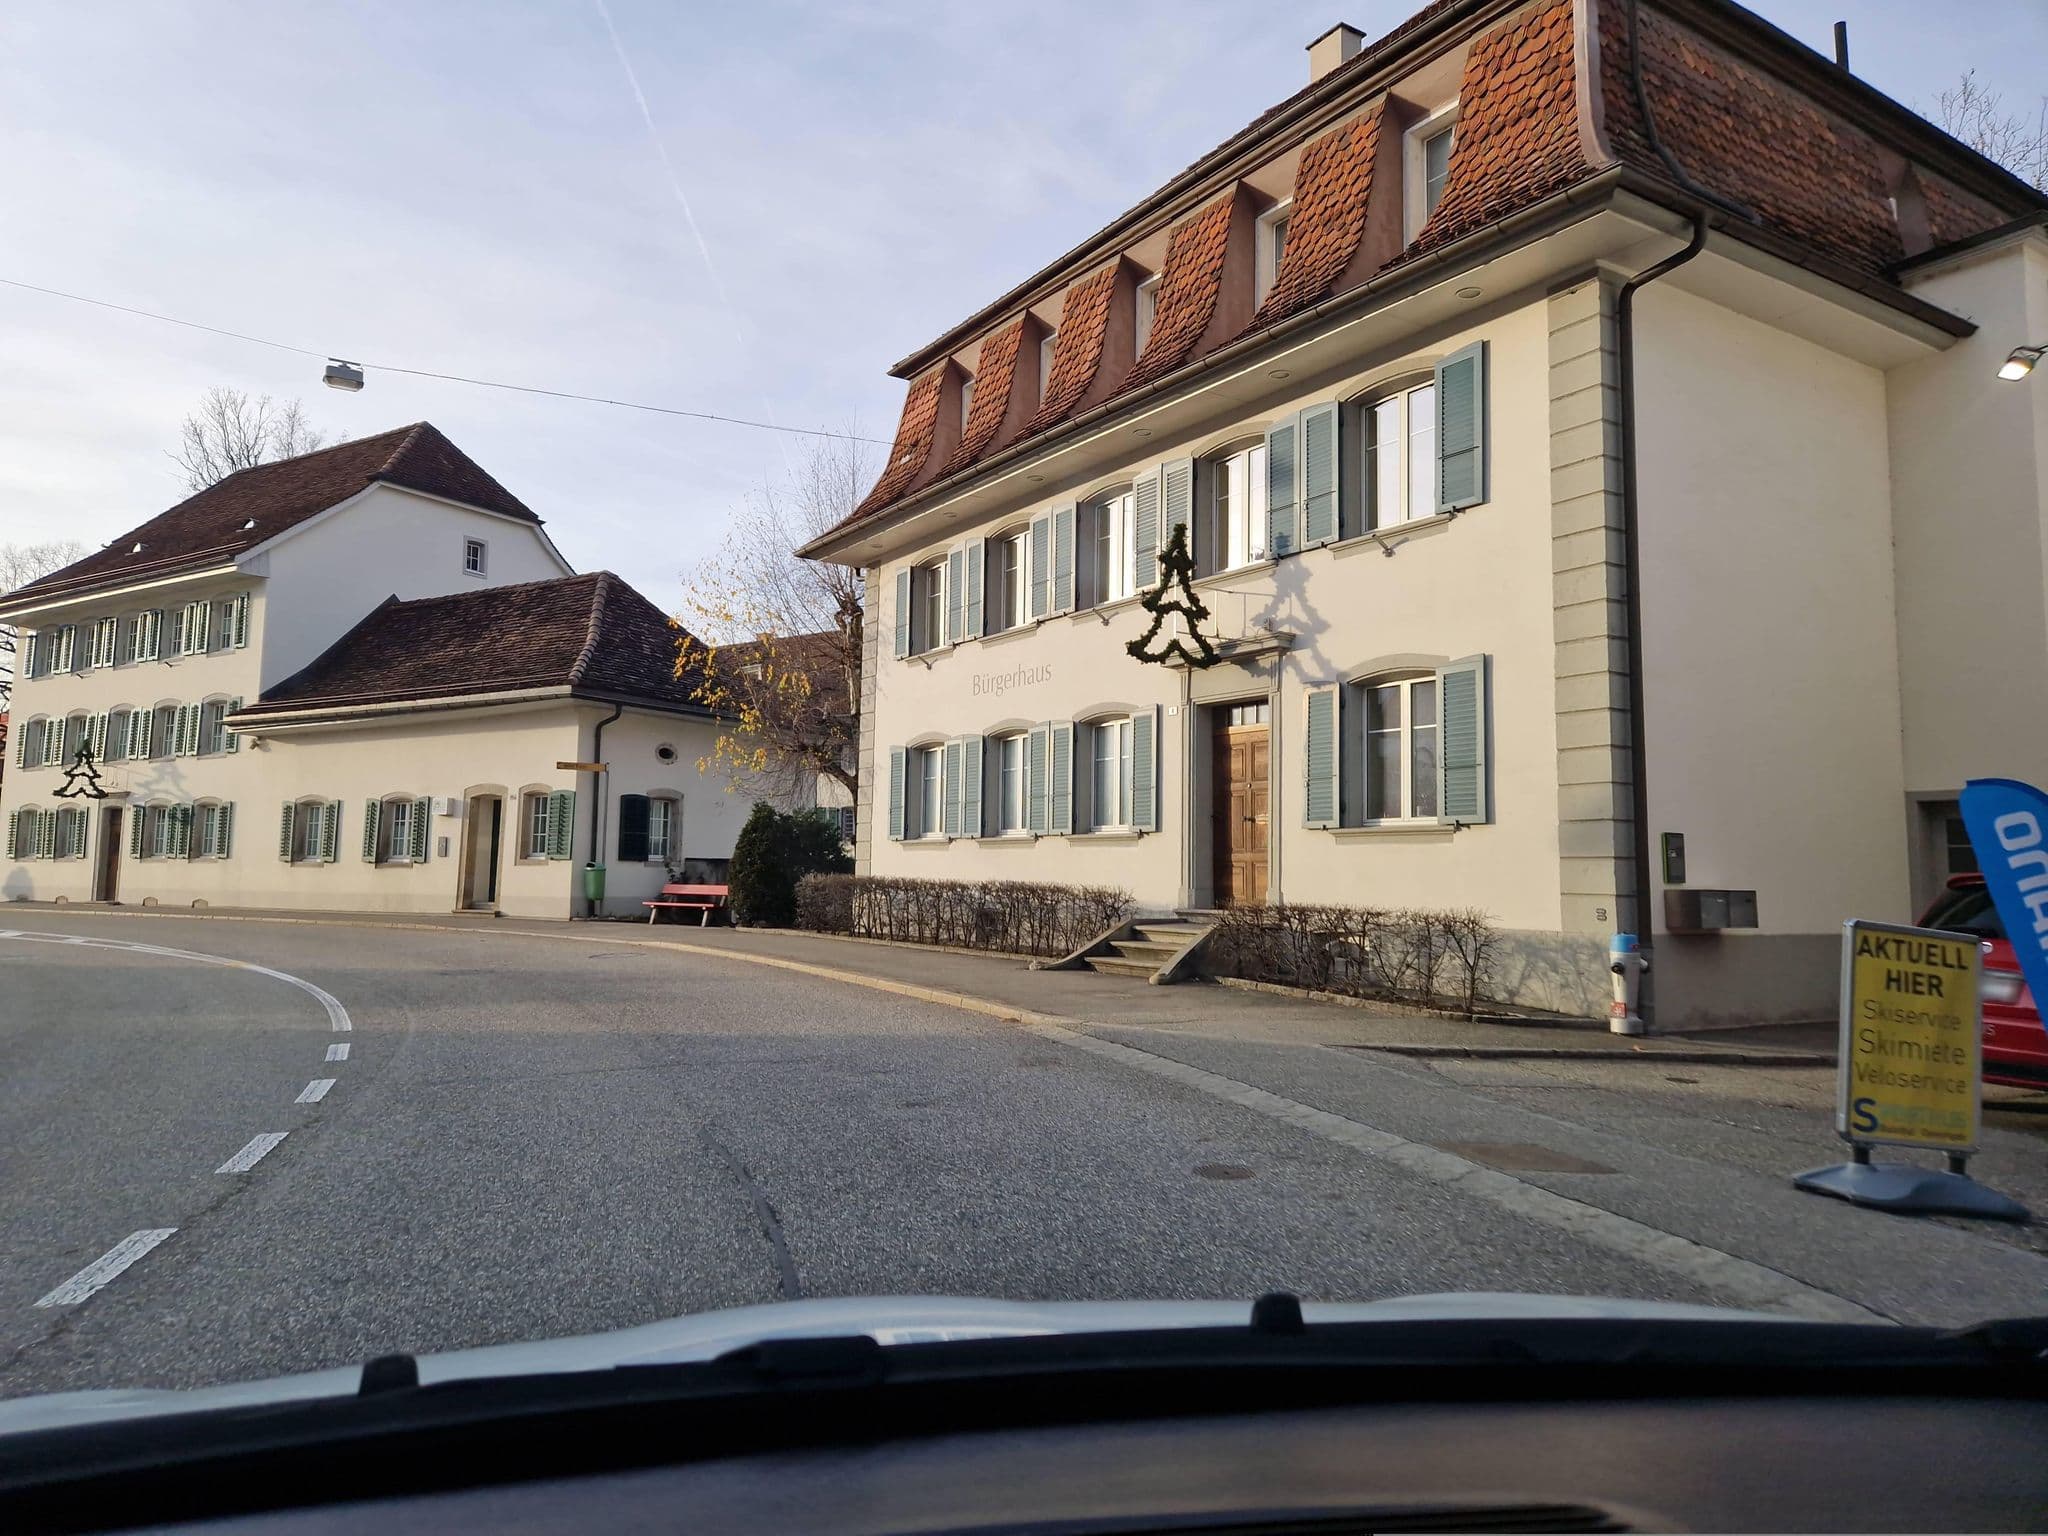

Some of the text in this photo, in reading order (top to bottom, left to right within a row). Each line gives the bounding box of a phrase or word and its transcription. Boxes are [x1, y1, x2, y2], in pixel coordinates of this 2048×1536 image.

[973, 663, 1052, 697] Bürgerhaus
[1856, 935, 1968, 970] AKTUELL
[1886, 968, 1944, 998] HIER
[1859, 1028, 1966, 1065] Skimiete
